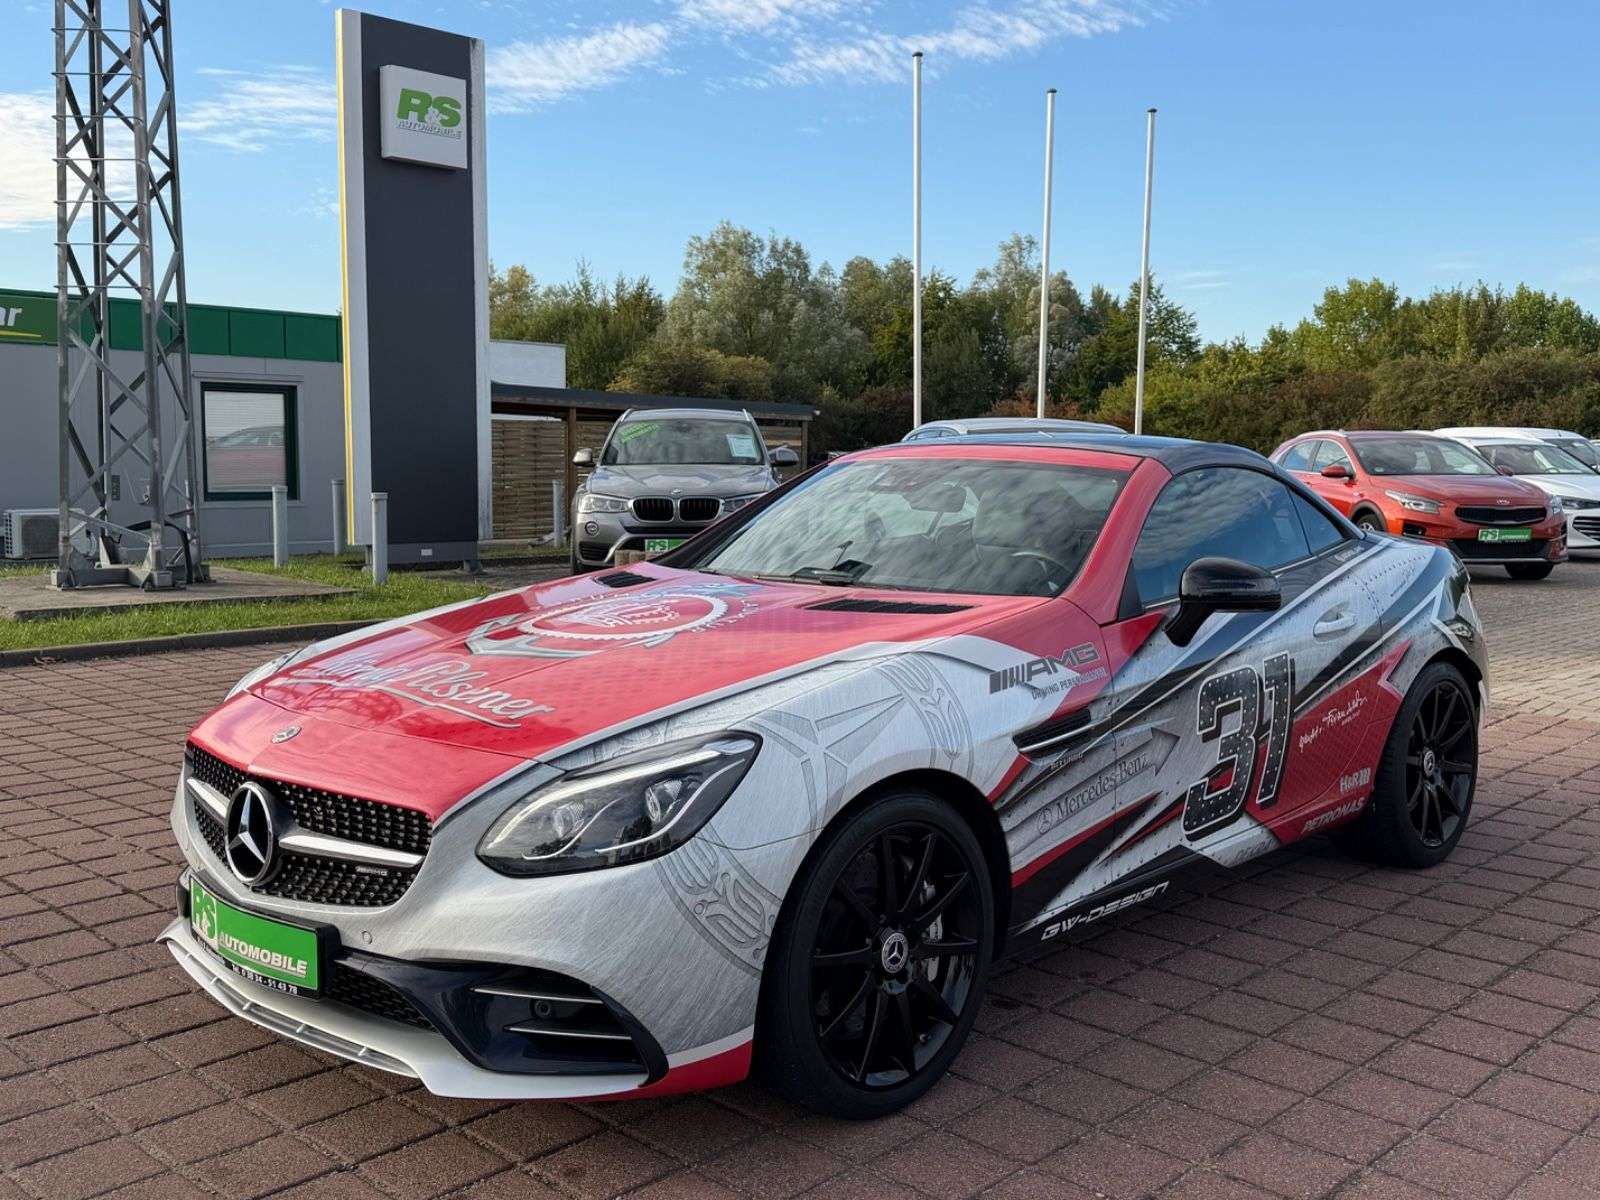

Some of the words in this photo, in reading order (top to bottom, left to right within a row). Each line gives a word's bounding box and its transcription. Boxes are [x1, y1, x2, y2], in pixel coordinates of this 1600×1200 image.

[397, 88, 461, 127] R&S
[1182, 652, 1292, 839] 31
[1301, 796, 1365, 834] PETRONAS
[1041, 880, 1170, 941] GW-DESIGN
[220, 931, 308, 975] AUTOMOBILE
